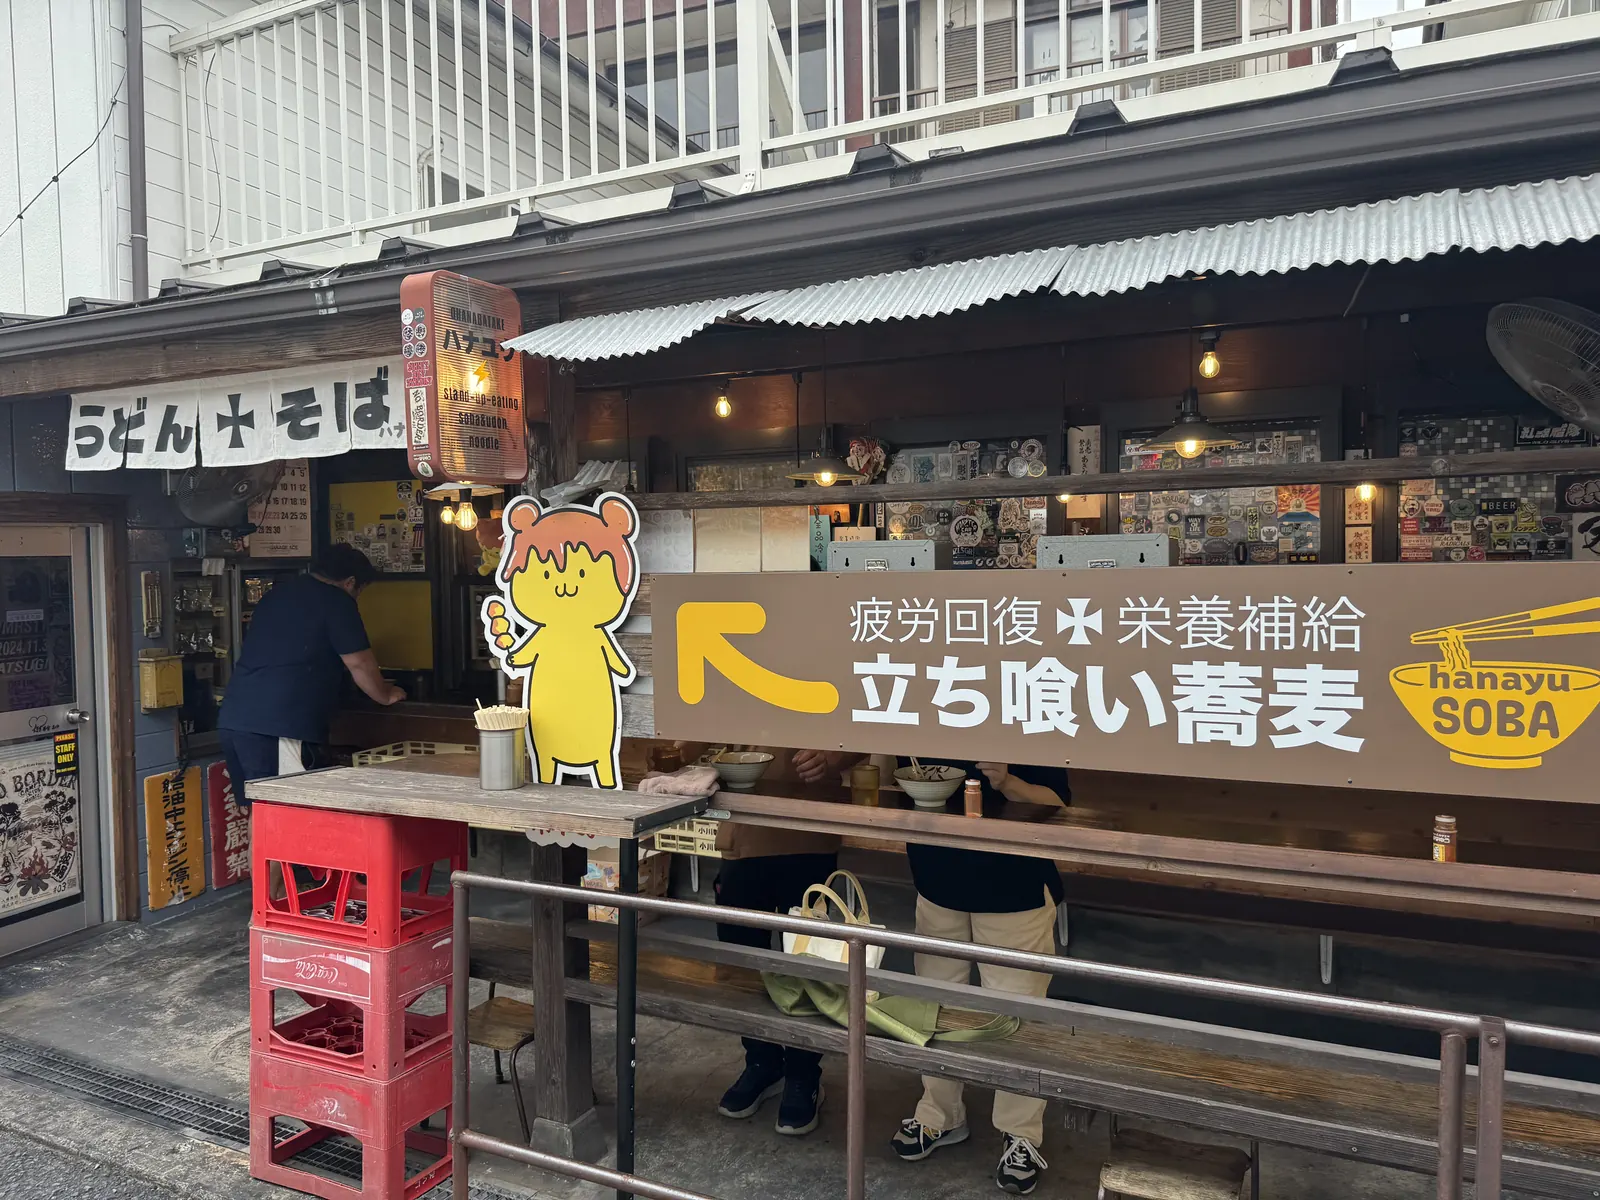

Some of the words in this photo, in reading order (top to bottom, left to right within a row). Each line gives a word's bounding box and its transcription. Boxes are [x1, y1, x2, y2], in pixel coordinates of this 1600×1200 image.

[443, 387, 519, 411] stand-up-eating
[74, 396, 194, 459] うどん
[276, 365, 391, 441] そば
[469, 435, 500, 450] noodle
[281, 512, 288, 520] 24
[290, 512, 298, 520] 25
[1488, 502, 1516, 510] BEER
[849, 596, 1044, 646] 疲労回復
[1117, 593, 1366, 652] 栄養補給
[1429, 663, 1570, 692] hanayu
[851, 653, 1366, 753] 立ち喰い蕎麦
[1432, 696, 1560, 739] SOBA
[55, 743, 76, 754] STAFF
[57, 753, 74, 764] ONLY
